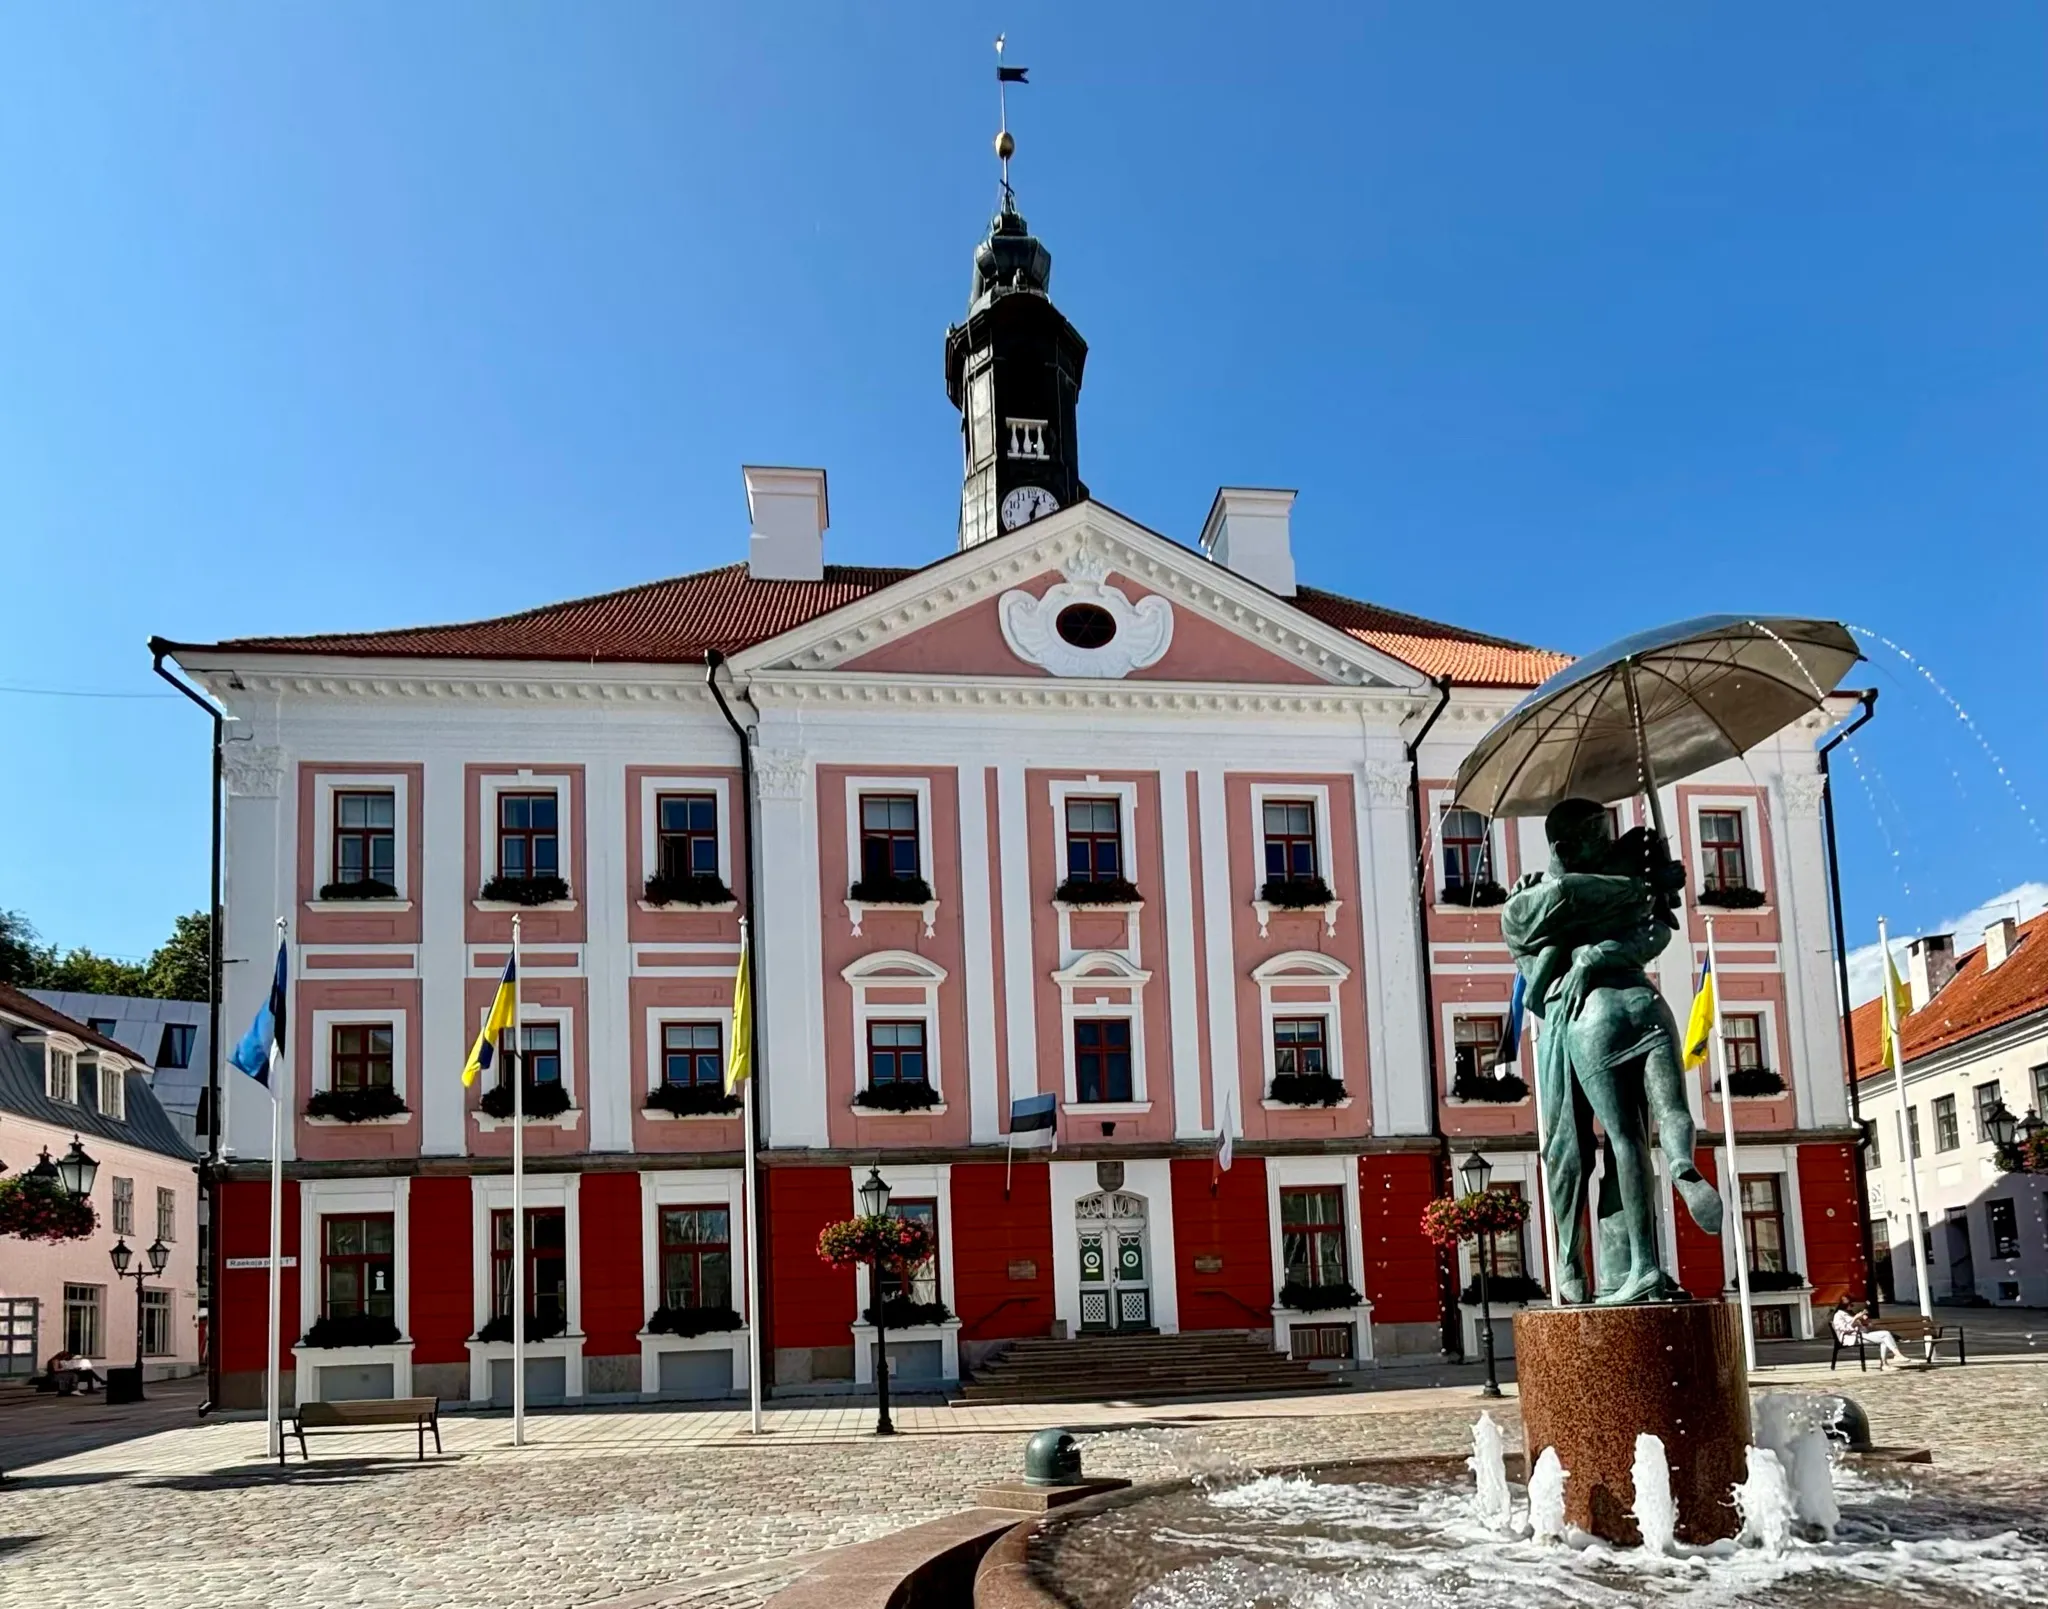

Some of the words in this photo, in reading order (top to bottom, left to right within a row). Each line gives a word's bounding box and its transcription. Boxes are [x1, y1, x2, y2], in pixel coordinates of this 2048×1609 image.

[1017, 491, 1025, 501] 11
[1027, 490, 1037, 499] 12
[1042, 494, 1047, 503] 1
[1009, 500, 1020, 510] 10
[1049, 502, 1056, 511] 2
[1005, 509, 1013, 518] 9
[229, 1259, 263, 1268] Raekoja
[375, 1270, 386, 1291] i
